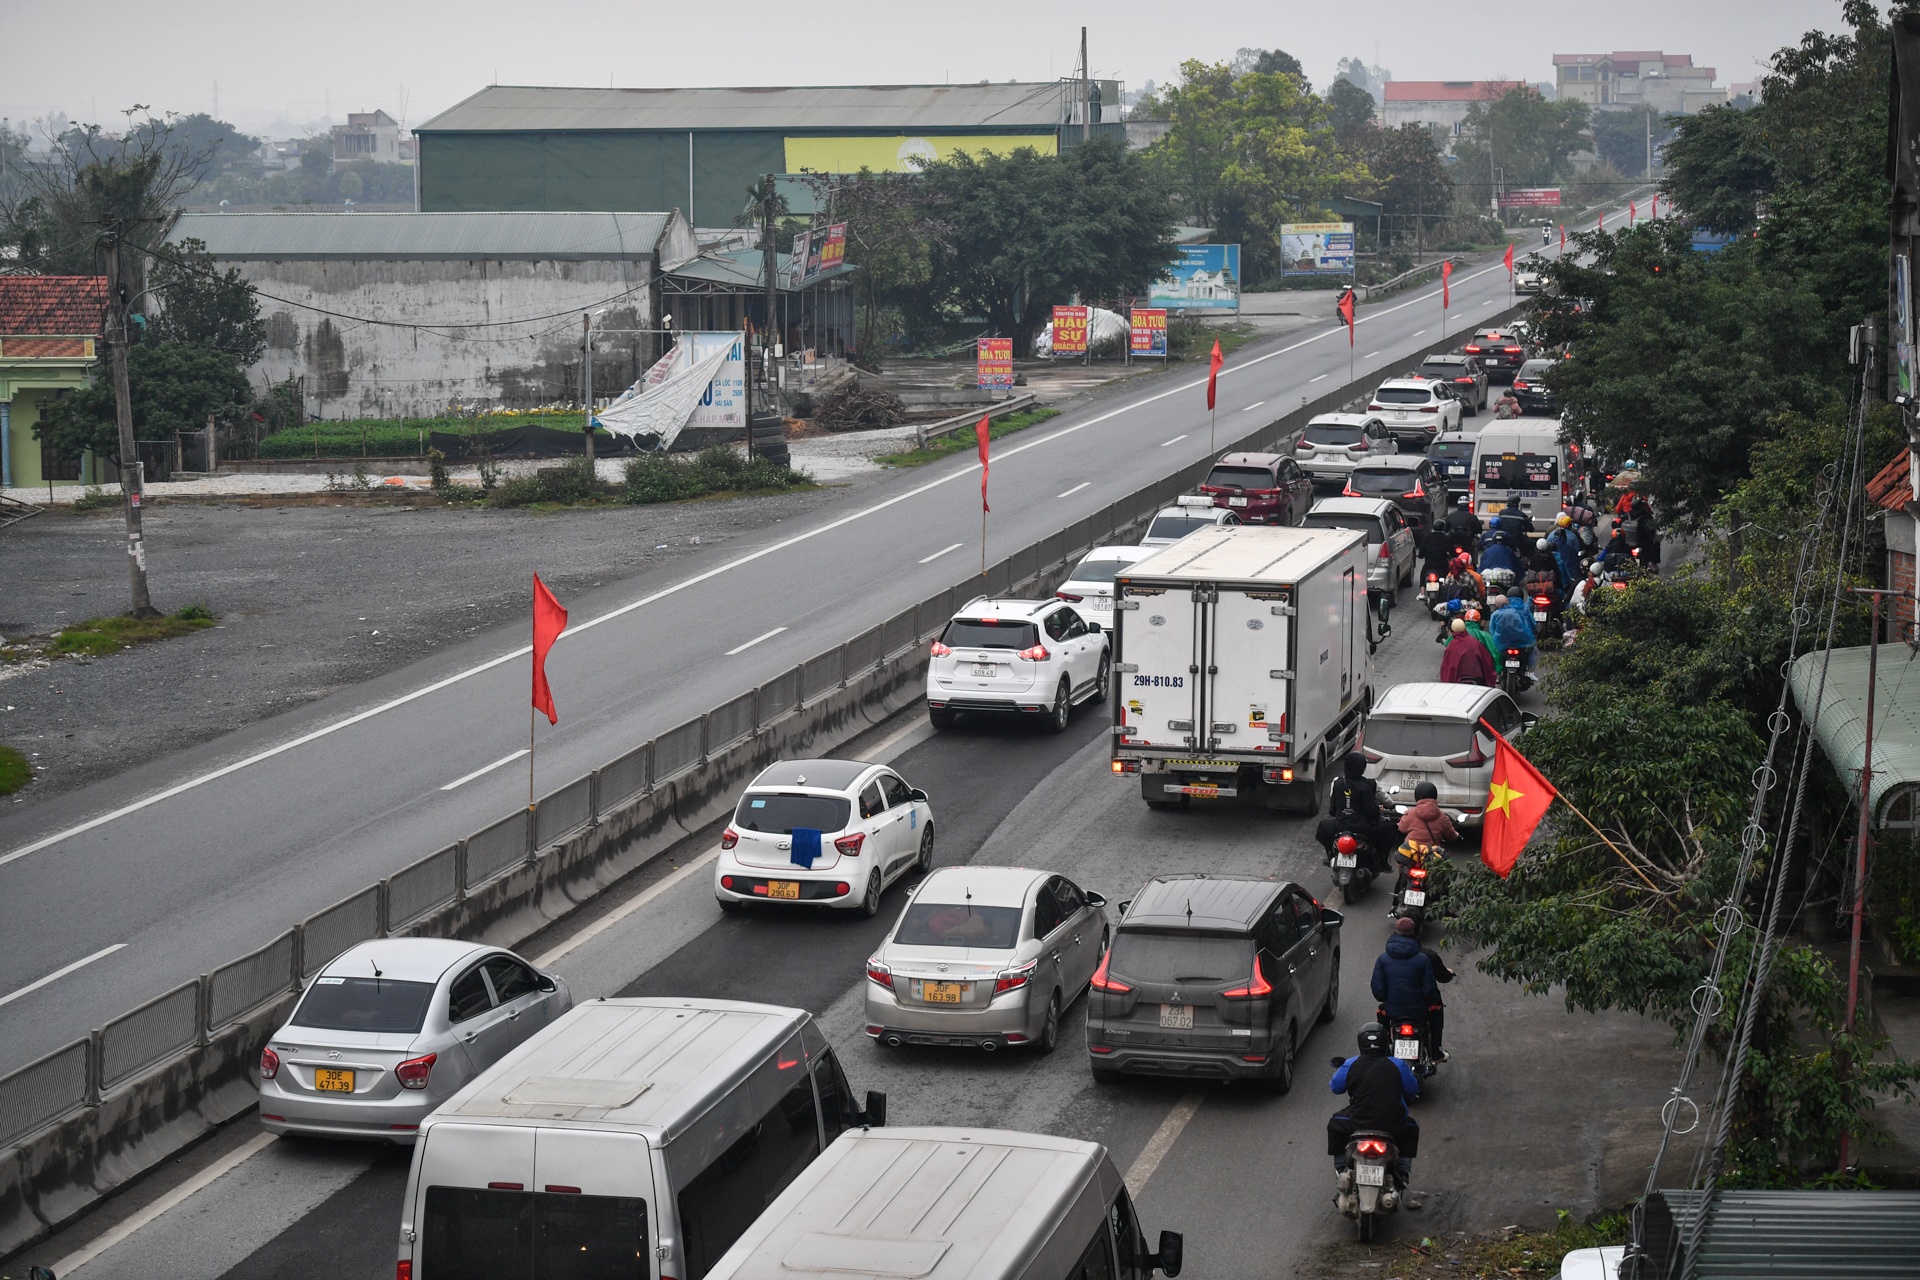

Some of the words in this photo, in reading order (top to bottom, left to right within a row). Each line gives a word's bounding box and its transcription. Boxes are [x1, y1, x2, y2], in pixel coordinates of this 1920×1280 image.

[1054, 317, 1087, 330] HẬU
[1132, 315, 1147, 328] HOA
[1148, 314, 1166, 328] TƯƠI
[1059, 330, 1084, 343] SỰ
[1053, 341, 1076, 351] QUÁCH
[980, 350, 994, 360] HOA
[995, 349, 1011, 360] TƯƠI
[732, 389, 743, 397] 250K
[699, 411, 717, 424] HẤP
[1133, 675, 1184, 688] 29H-810.83
[777, 882, 791, 890] 30F
[771, 889, 796, 898] 290.63
[934, 984, 950, 992] 30F
[928, 992, 957, 1002] 163.98
[1168, 1004, 1186, 1016] 23A
[1161, 1016, 1192, 1027] 067.02
[326, 1071, 343, 1080] 30E
[319, 1080, 349, 1090] 471.39
